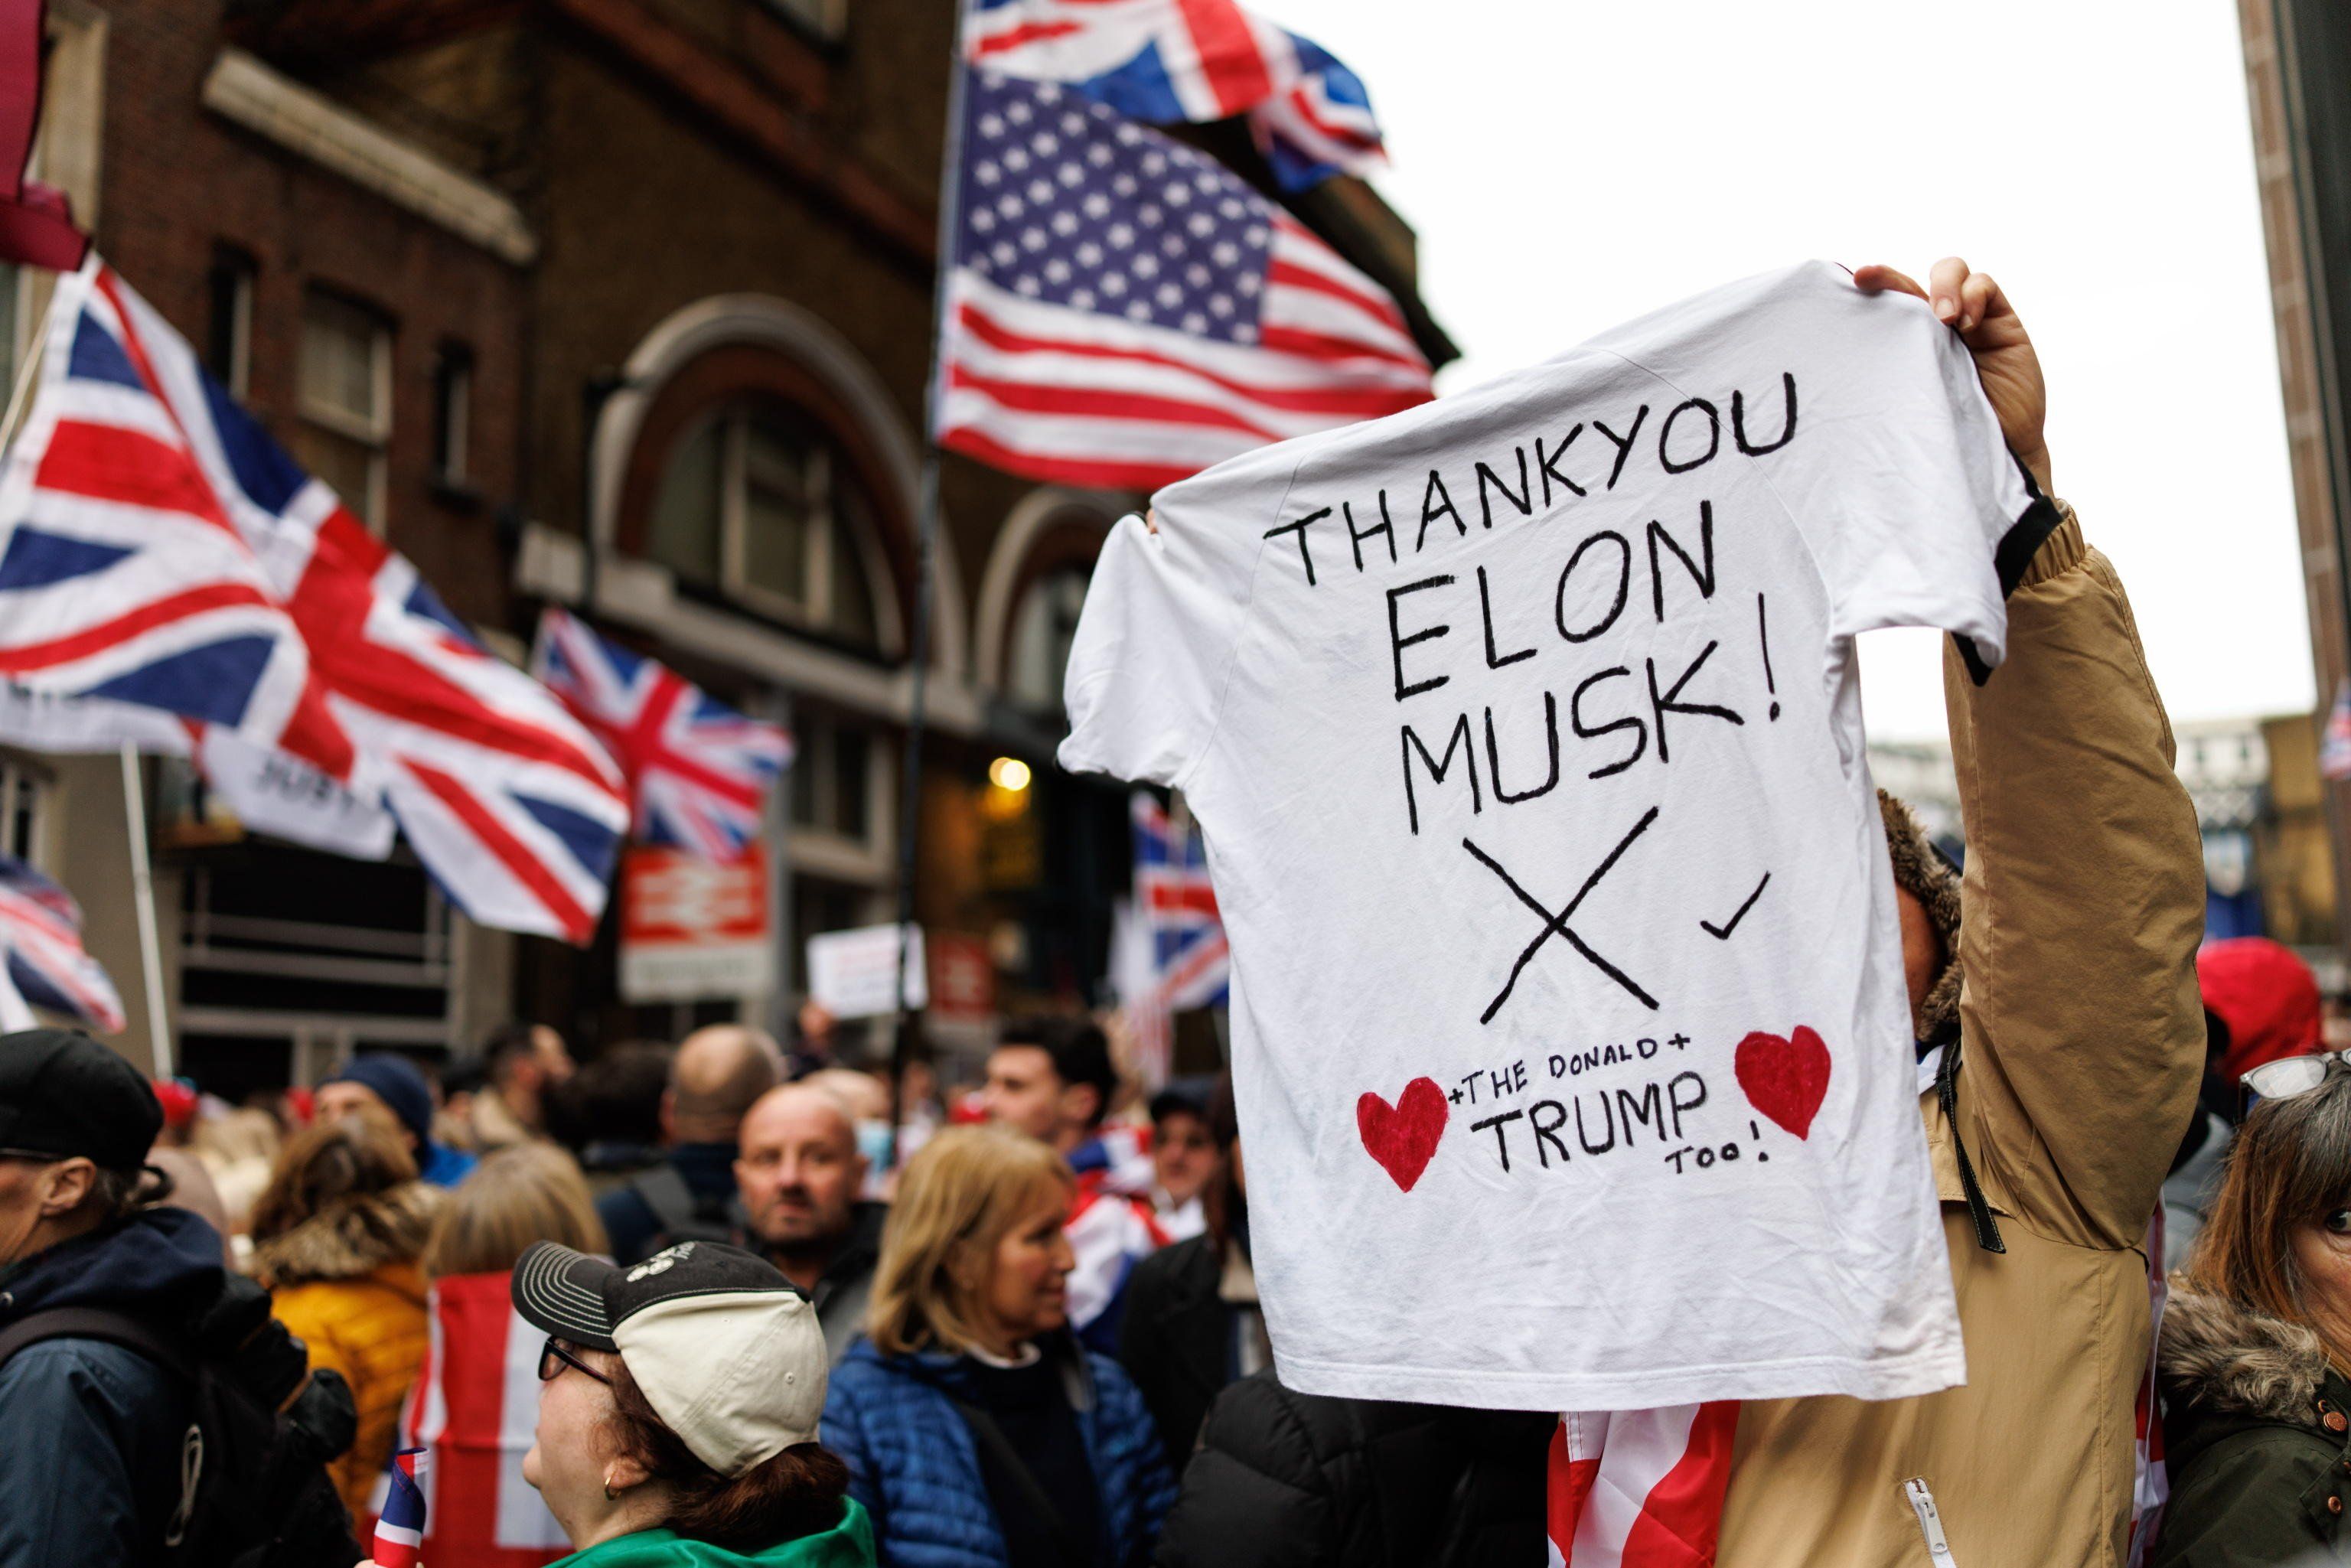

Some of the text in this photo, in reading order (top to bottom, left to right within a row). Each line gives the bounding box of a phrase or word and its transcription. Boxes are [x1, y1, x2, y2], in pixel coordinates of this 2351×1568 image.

[1385, 499, 1717, 703] ELON
[1400, 591, 1782, 836] MUSK!
[1469, 1070, 1708, 1174] TRUMP
